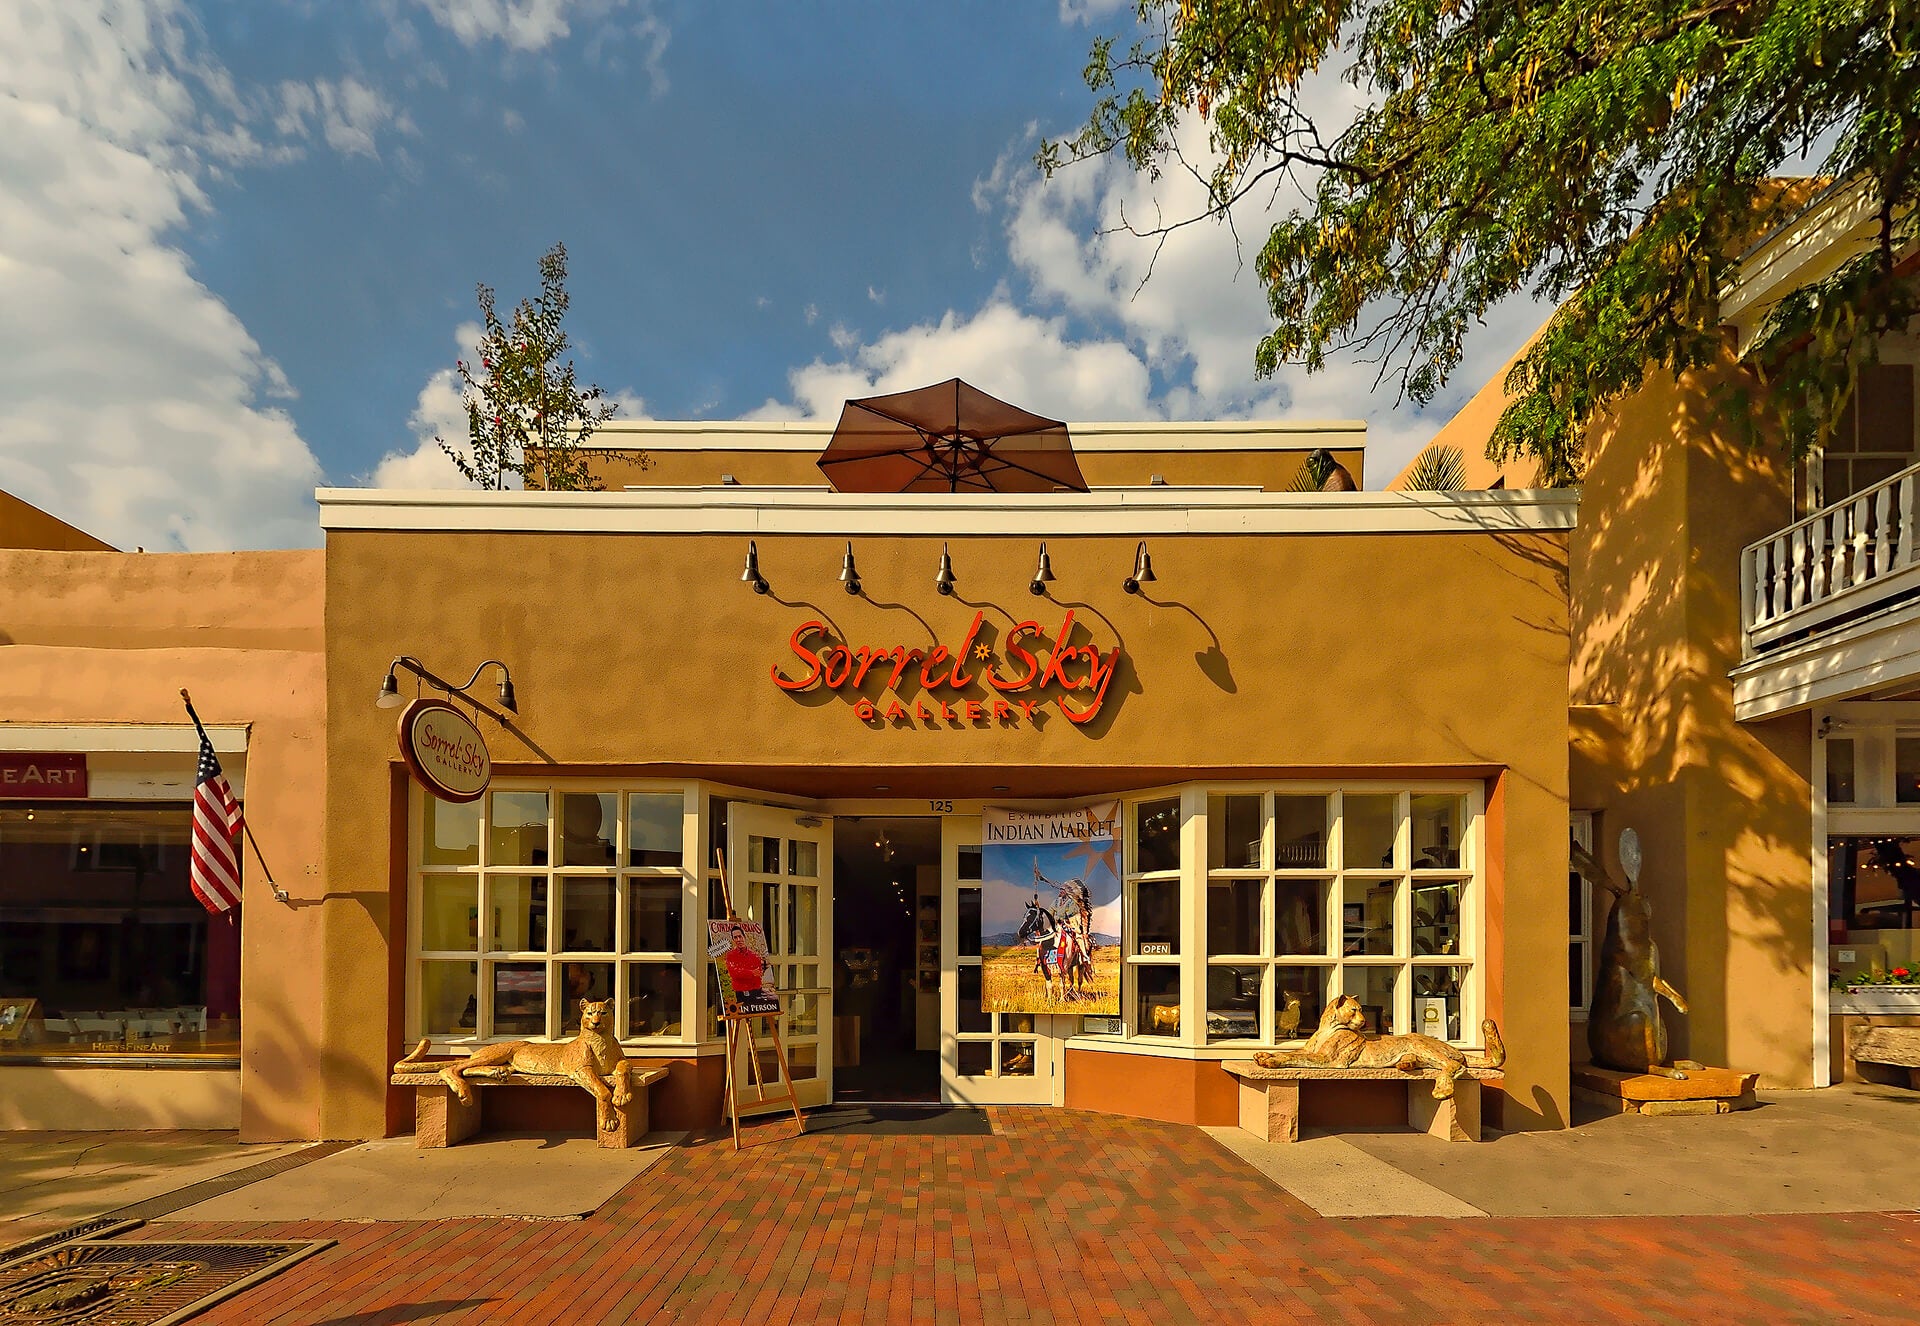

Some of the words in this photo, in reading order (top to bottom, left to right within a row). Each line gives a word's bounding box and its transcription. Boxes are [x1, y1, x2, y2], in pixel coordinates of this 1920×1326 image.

[770, 610, 984, 690] Sorrel
[986, 609, 1120, 723] Sky
[853, 700, 1038, 720] GALLERY
[420, 723, 462, 760] Sorrel
[461, 743, 484, 778] Sky
[436, 755, 473, 776] GALLERY
[929, 800, 953, 813] 125
[987, 822, 1044, 841] INDIAN
[1050, 819, 1117, 840] MARKET
[1143, 944, 1169, 954] OPEN
[740, 1004, 750, 1013] IN
[750, 1003, 778, 1013] PERSON
